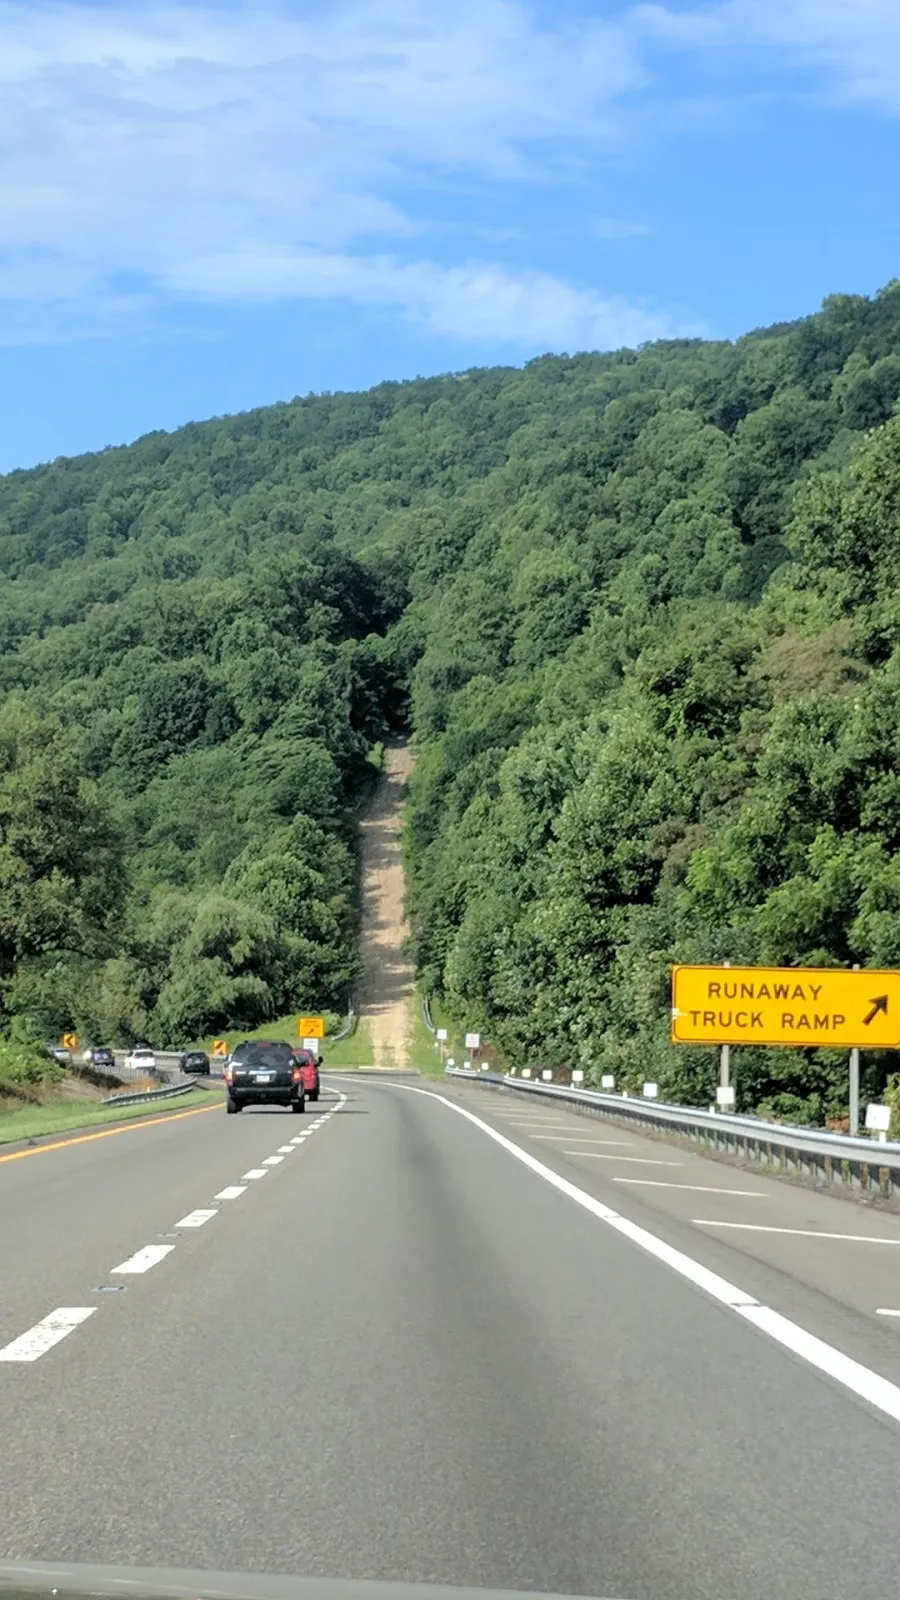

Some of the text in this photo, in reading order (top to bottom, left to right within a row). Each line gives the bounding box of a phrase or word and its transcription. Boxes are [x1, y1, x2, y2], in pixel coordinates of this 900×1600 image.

[708, 982, 822, 1000] RUNAWAY
[689, 1010, 846, 1030] TRUCK RAMP
